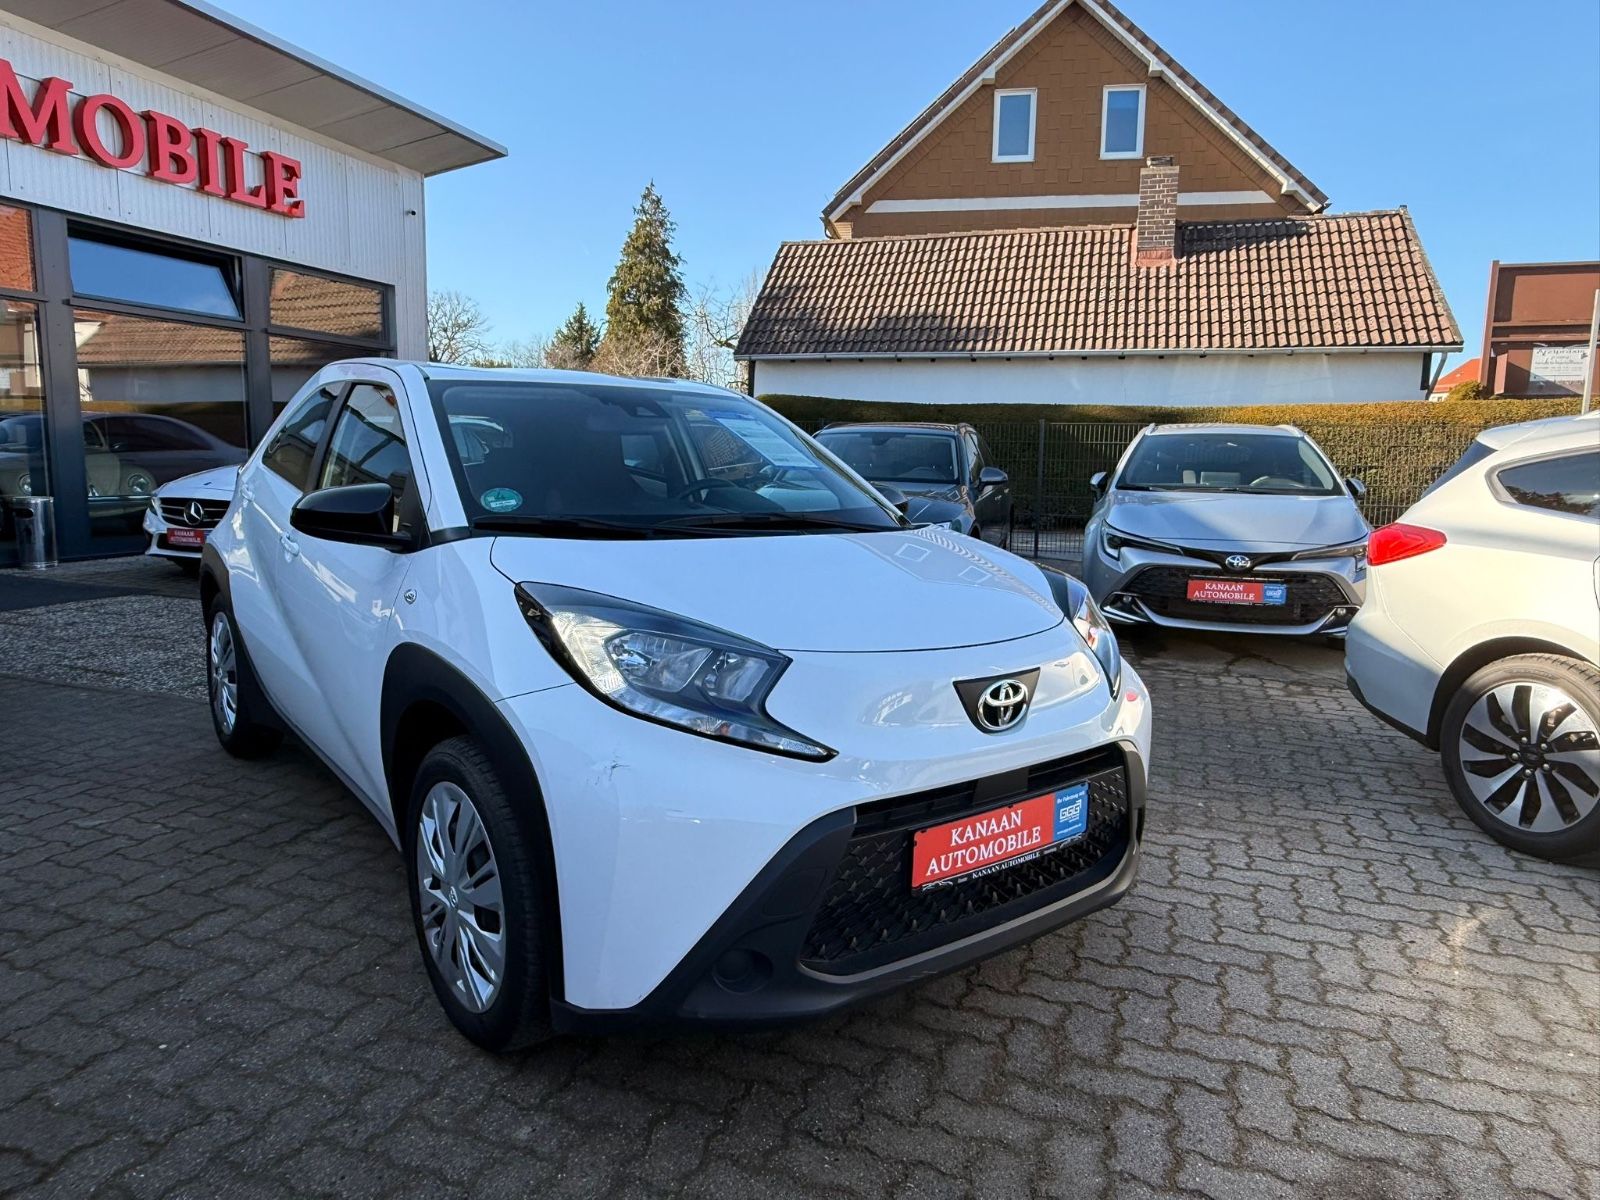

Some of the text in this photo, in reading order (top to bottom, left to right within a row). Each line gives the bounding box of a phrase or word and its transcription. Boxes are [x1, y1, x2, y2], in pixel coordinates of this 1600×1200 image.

[0, 58, 305, 219] MOBILE
[1193, 591, 1255, 600] AUTOMOBILE
[1205, 582, 1244, 591] KANAAN
[950, 810, 1022, 846] KANAAN
[925, 826, 1041, 876] AUTOMOBILE
[972, 865, 1000, 880] KANAAN
[1000, 852, 1041, 871] AUTOMOBILE
